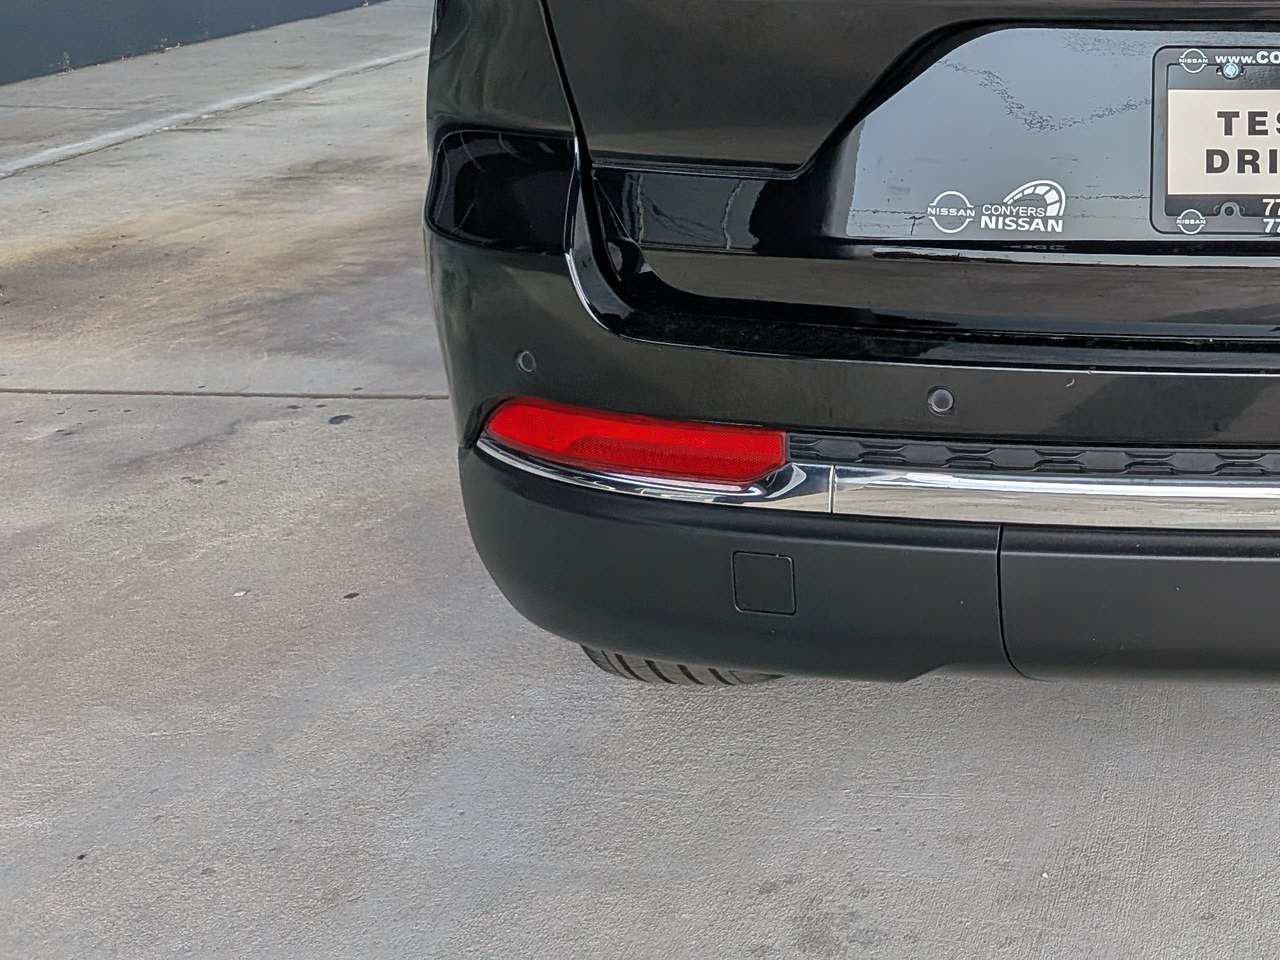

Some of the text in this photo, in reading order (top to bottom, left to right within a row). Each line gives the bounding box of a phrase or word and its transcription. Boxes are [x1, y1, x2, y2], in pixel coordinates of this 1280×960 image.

[927, 206, 976, 217] NISSAN
[982, 204, 1045, 217] CONYERS
[980, 215, 1063, 233] NISSAN
